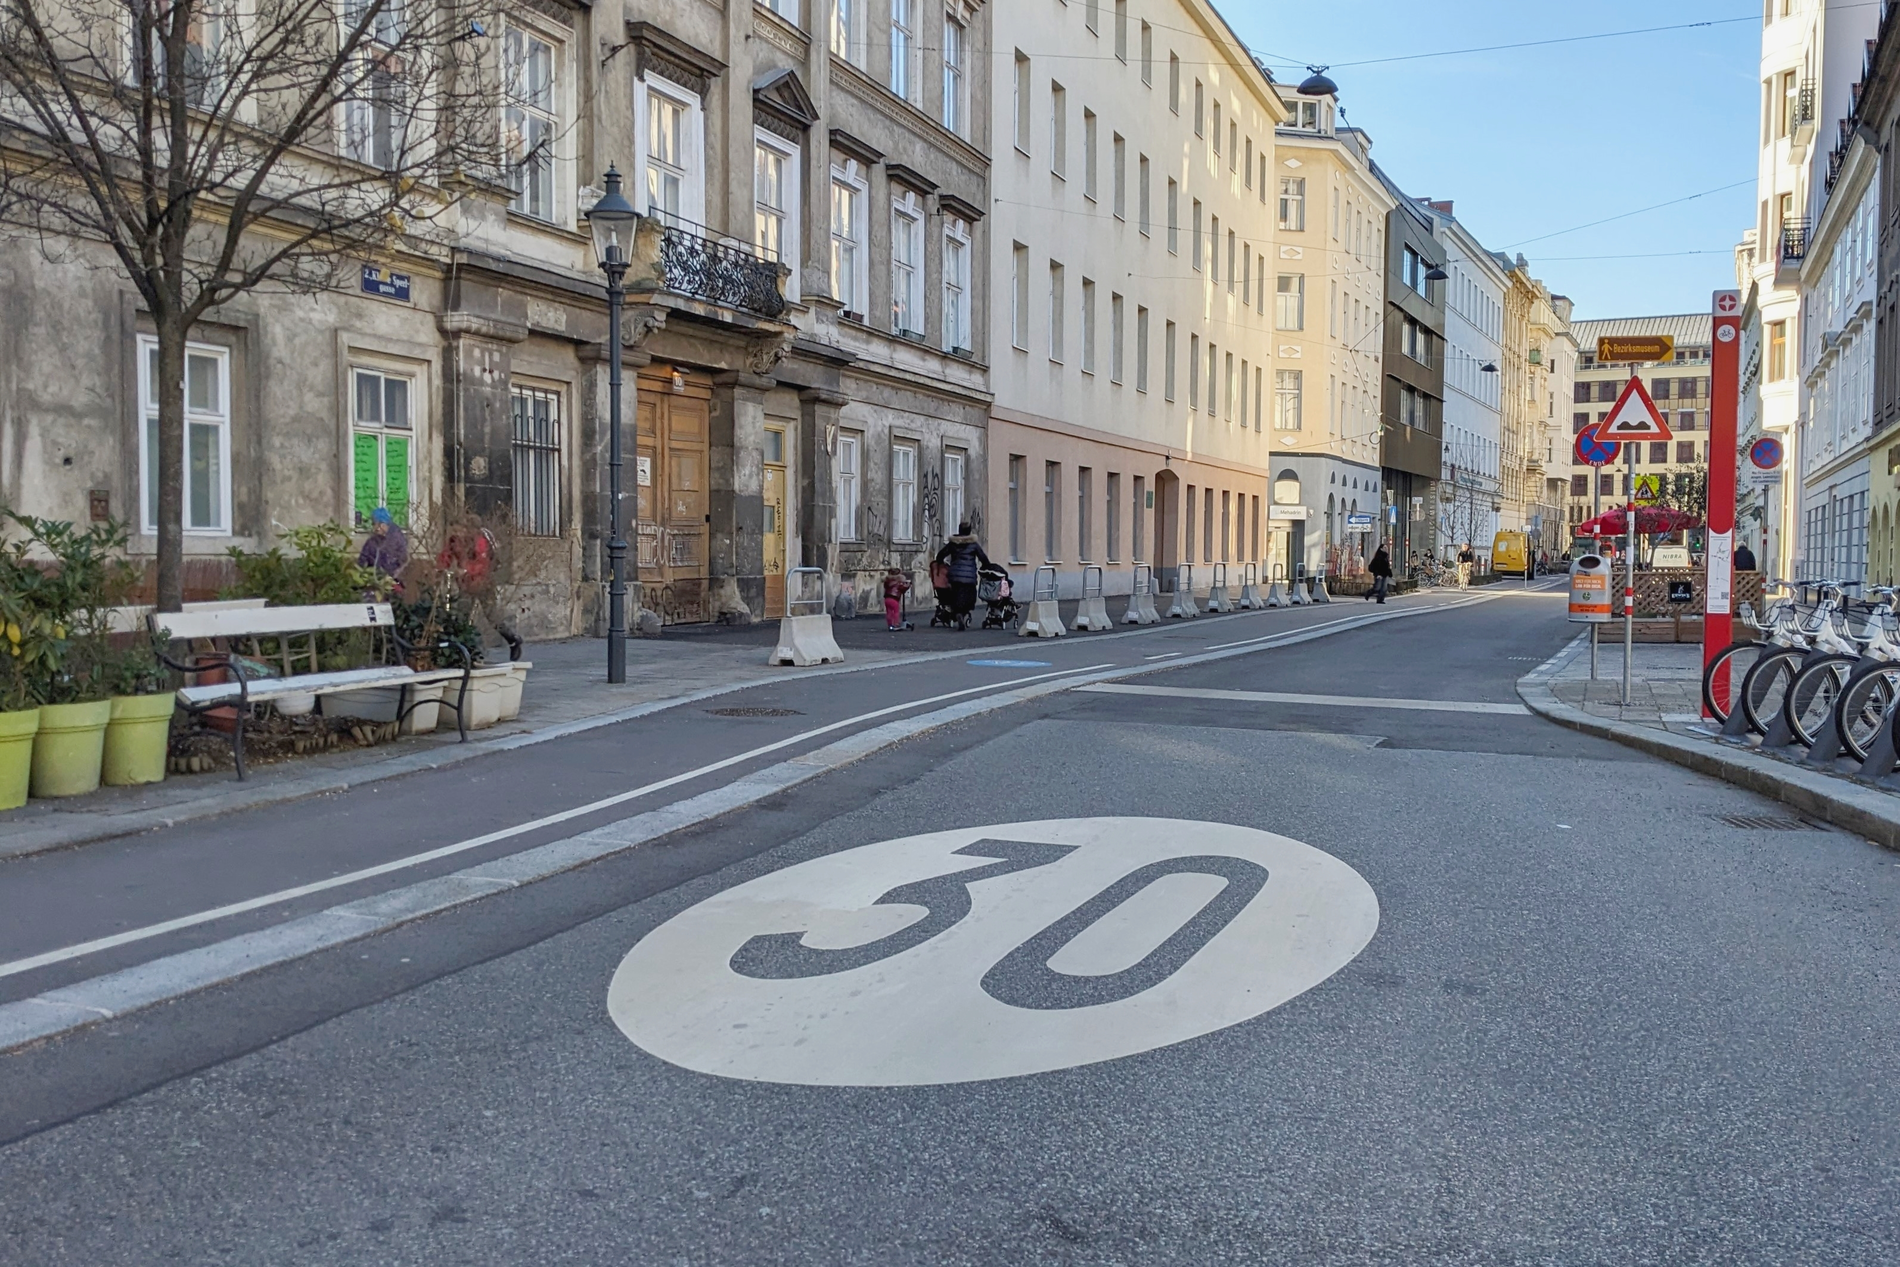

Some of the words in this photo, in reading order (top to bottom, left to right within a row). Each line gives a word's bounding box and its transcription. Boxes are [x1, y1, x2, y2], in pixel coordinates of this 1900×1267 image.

[372, 270, 391, 284] Kle
[392, 275, 410, 288] Sperl-
[379, 284, 395, 294] gasse
[1613, 344, 1660, 353] Bezirksmuseum
[675, 377, 682, 386] 10
[729, 838, 1269, 1010] 30
